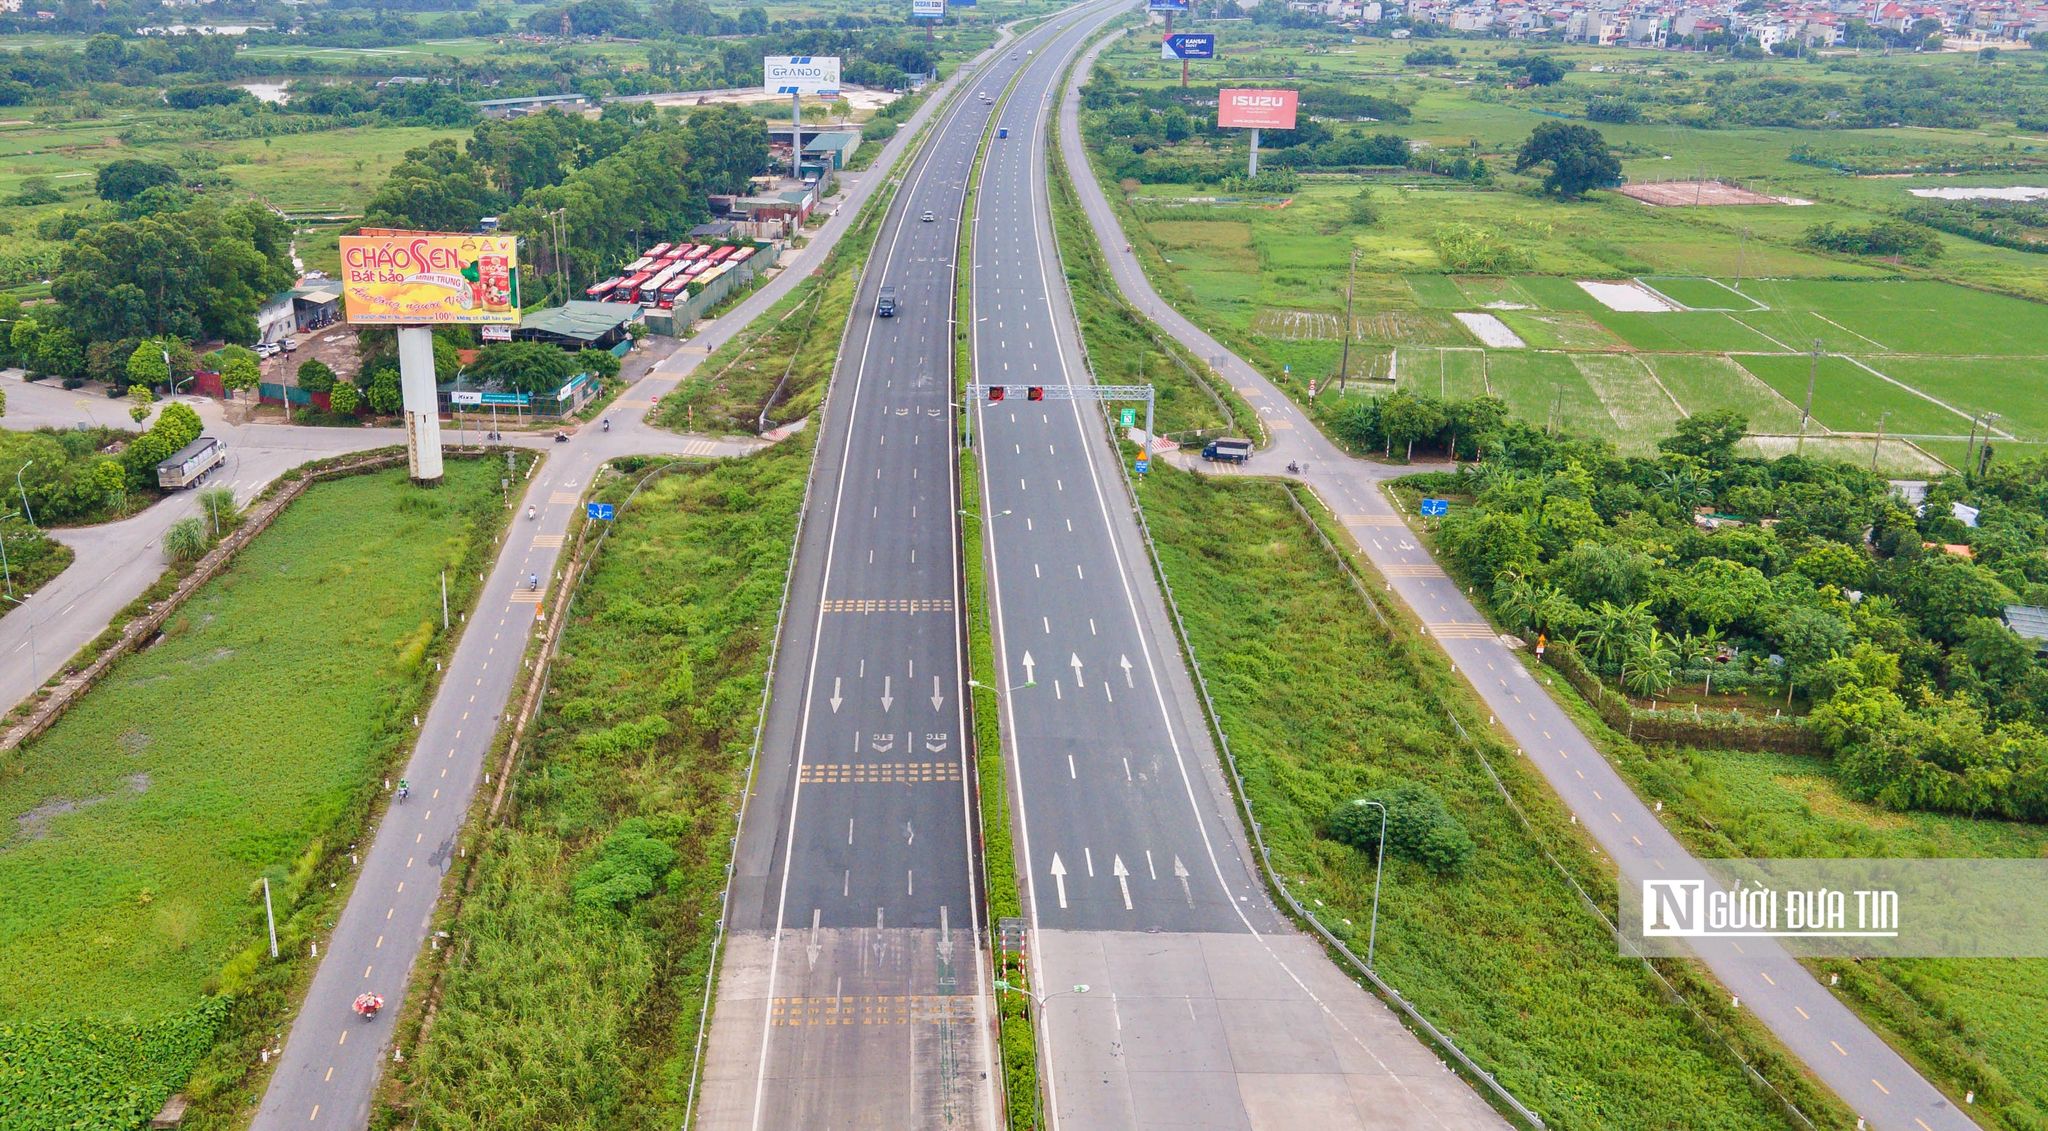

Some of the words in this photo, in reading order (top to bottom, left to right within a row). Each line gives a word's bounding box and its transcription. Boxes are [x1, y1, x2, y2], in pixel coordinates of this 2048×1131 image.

[772, 68, 821, 76] GRANDO
[1232, 95, 1283, 107] ISUZU
[351, 270, 375, 282] Bát
[379, 269, 404, 284] bảo
[437, 276, 461, 288] TRUNG
